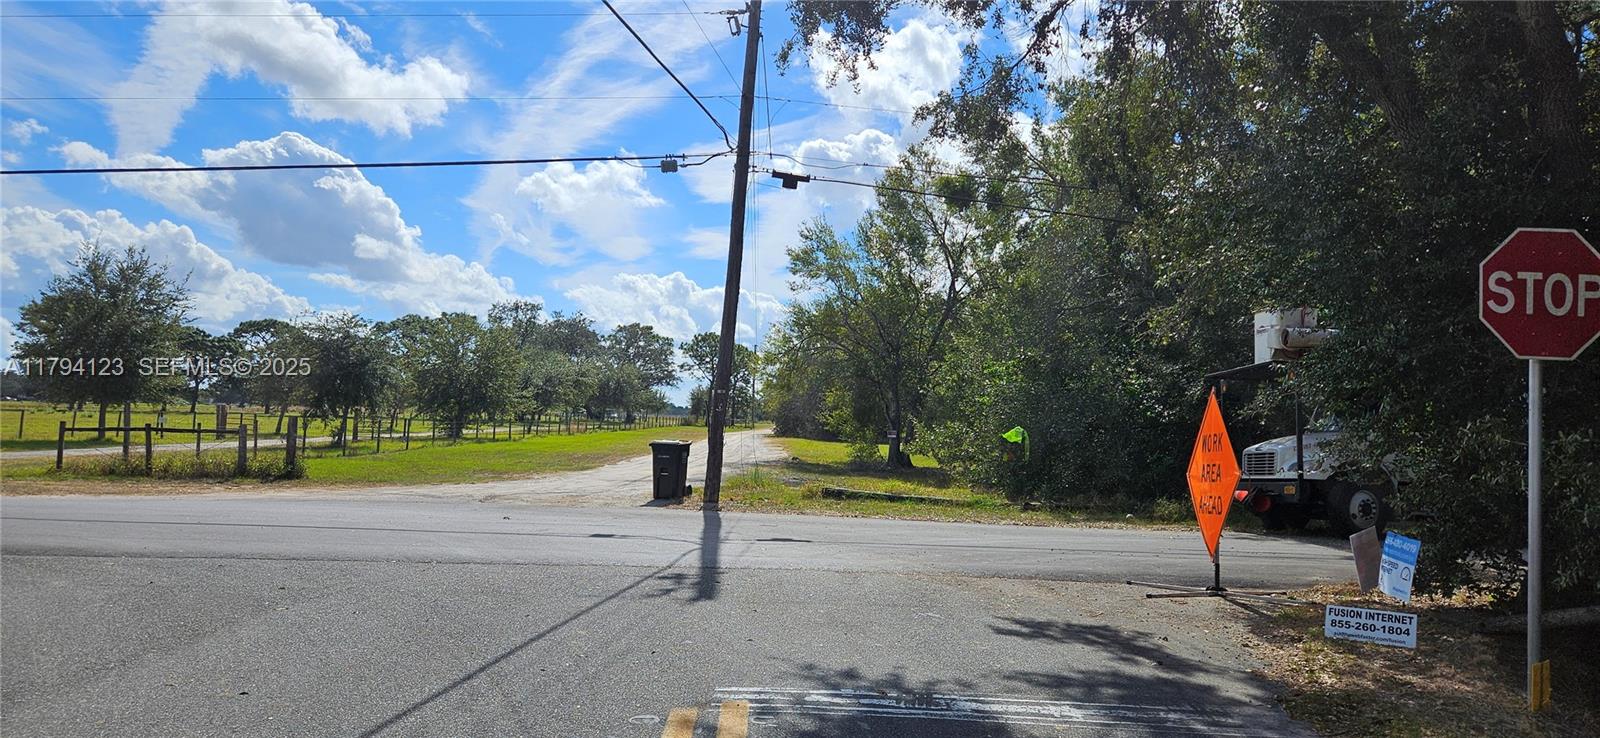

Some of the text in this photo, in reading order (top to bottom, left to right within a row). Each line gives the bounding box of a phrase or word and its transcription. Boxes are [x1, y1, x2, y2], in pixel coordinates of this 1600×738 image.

[1487, 271, 1600, 317] STOP
[1201, 432, 1223, 453] WORK
[1201, 464, 1221, 483] AREA
[1200, 496, 1223, 516] AHEAD
[1328, 607, 1414, 625] FUSION INTERNET
[1330, 619, 1410, 637] 855-260-1804
